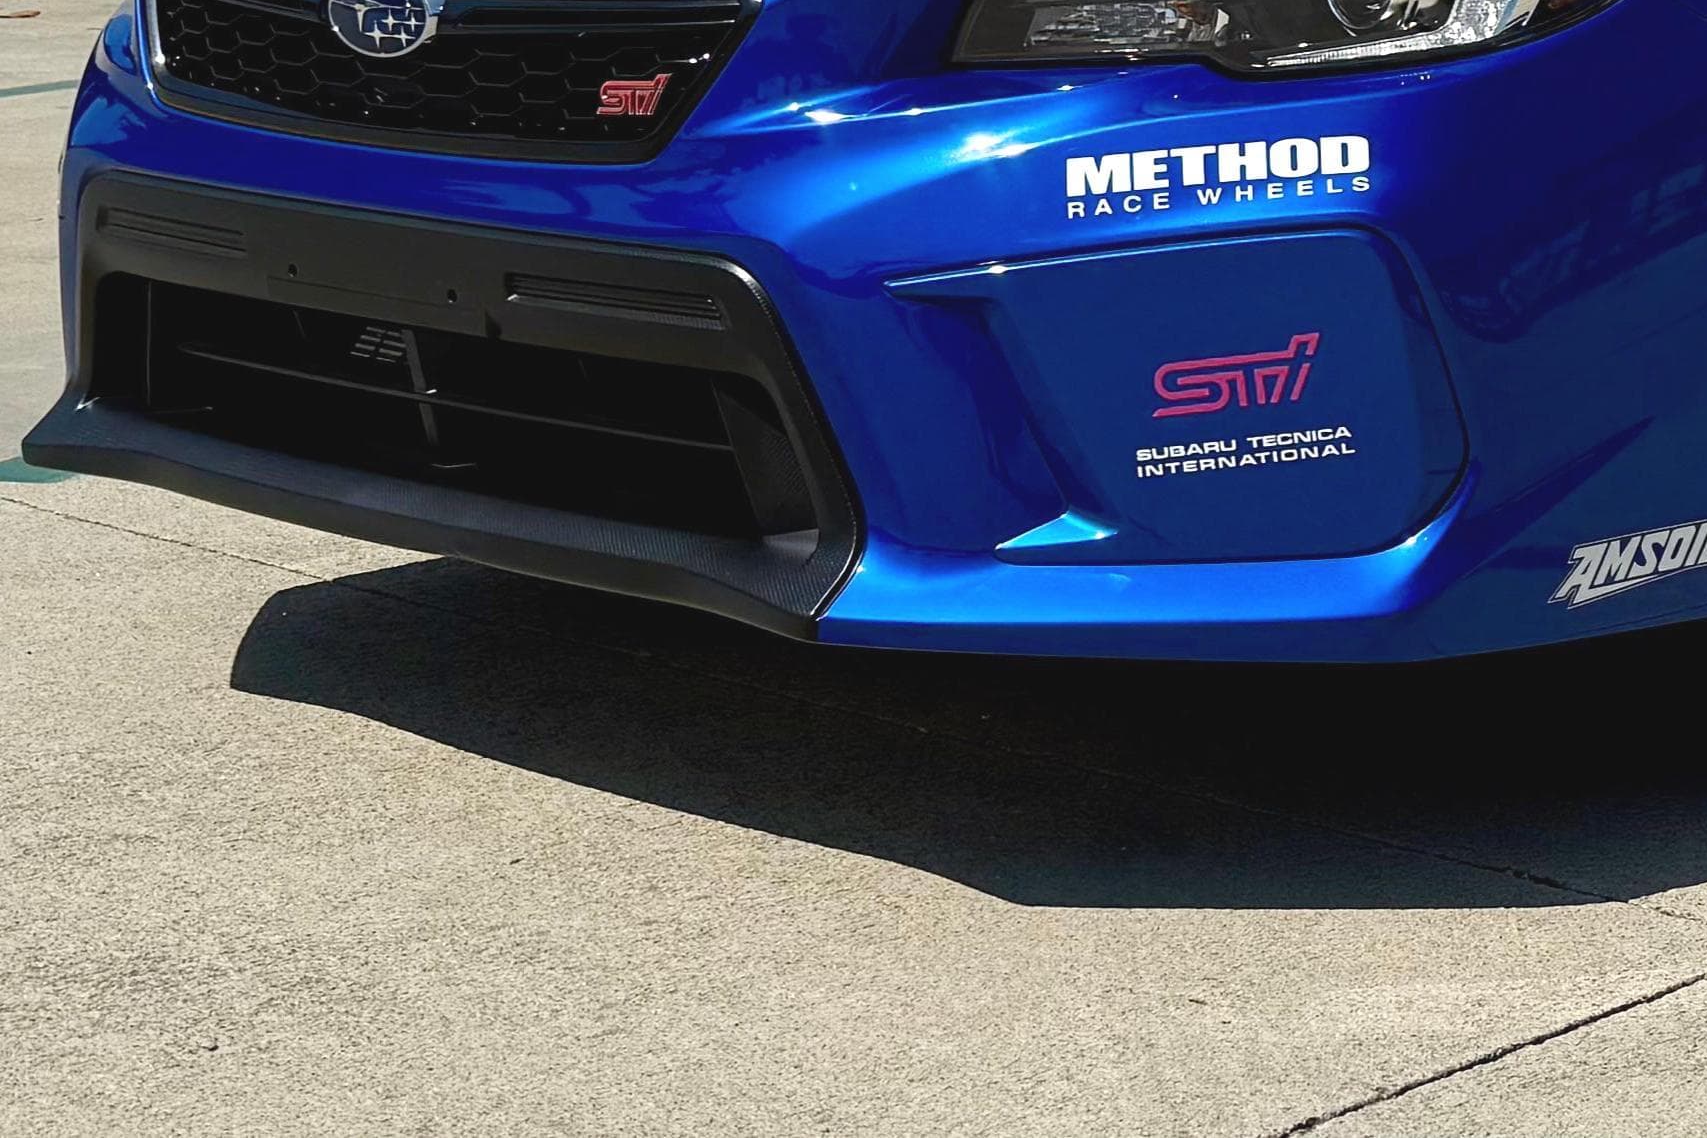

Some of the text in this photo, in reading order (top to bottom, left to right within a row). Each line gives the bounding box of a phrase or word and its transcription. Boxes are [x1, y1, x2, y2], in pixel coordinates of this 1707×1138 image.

[1066, 135, 1370, 198] METHOD
[1067, 176, 1371, 219] RACE WHEELS
[1136, 426, 1352, 462] SUBARU TECNICA
[1137, 443, 1356, 478] INTERNATIONAL
